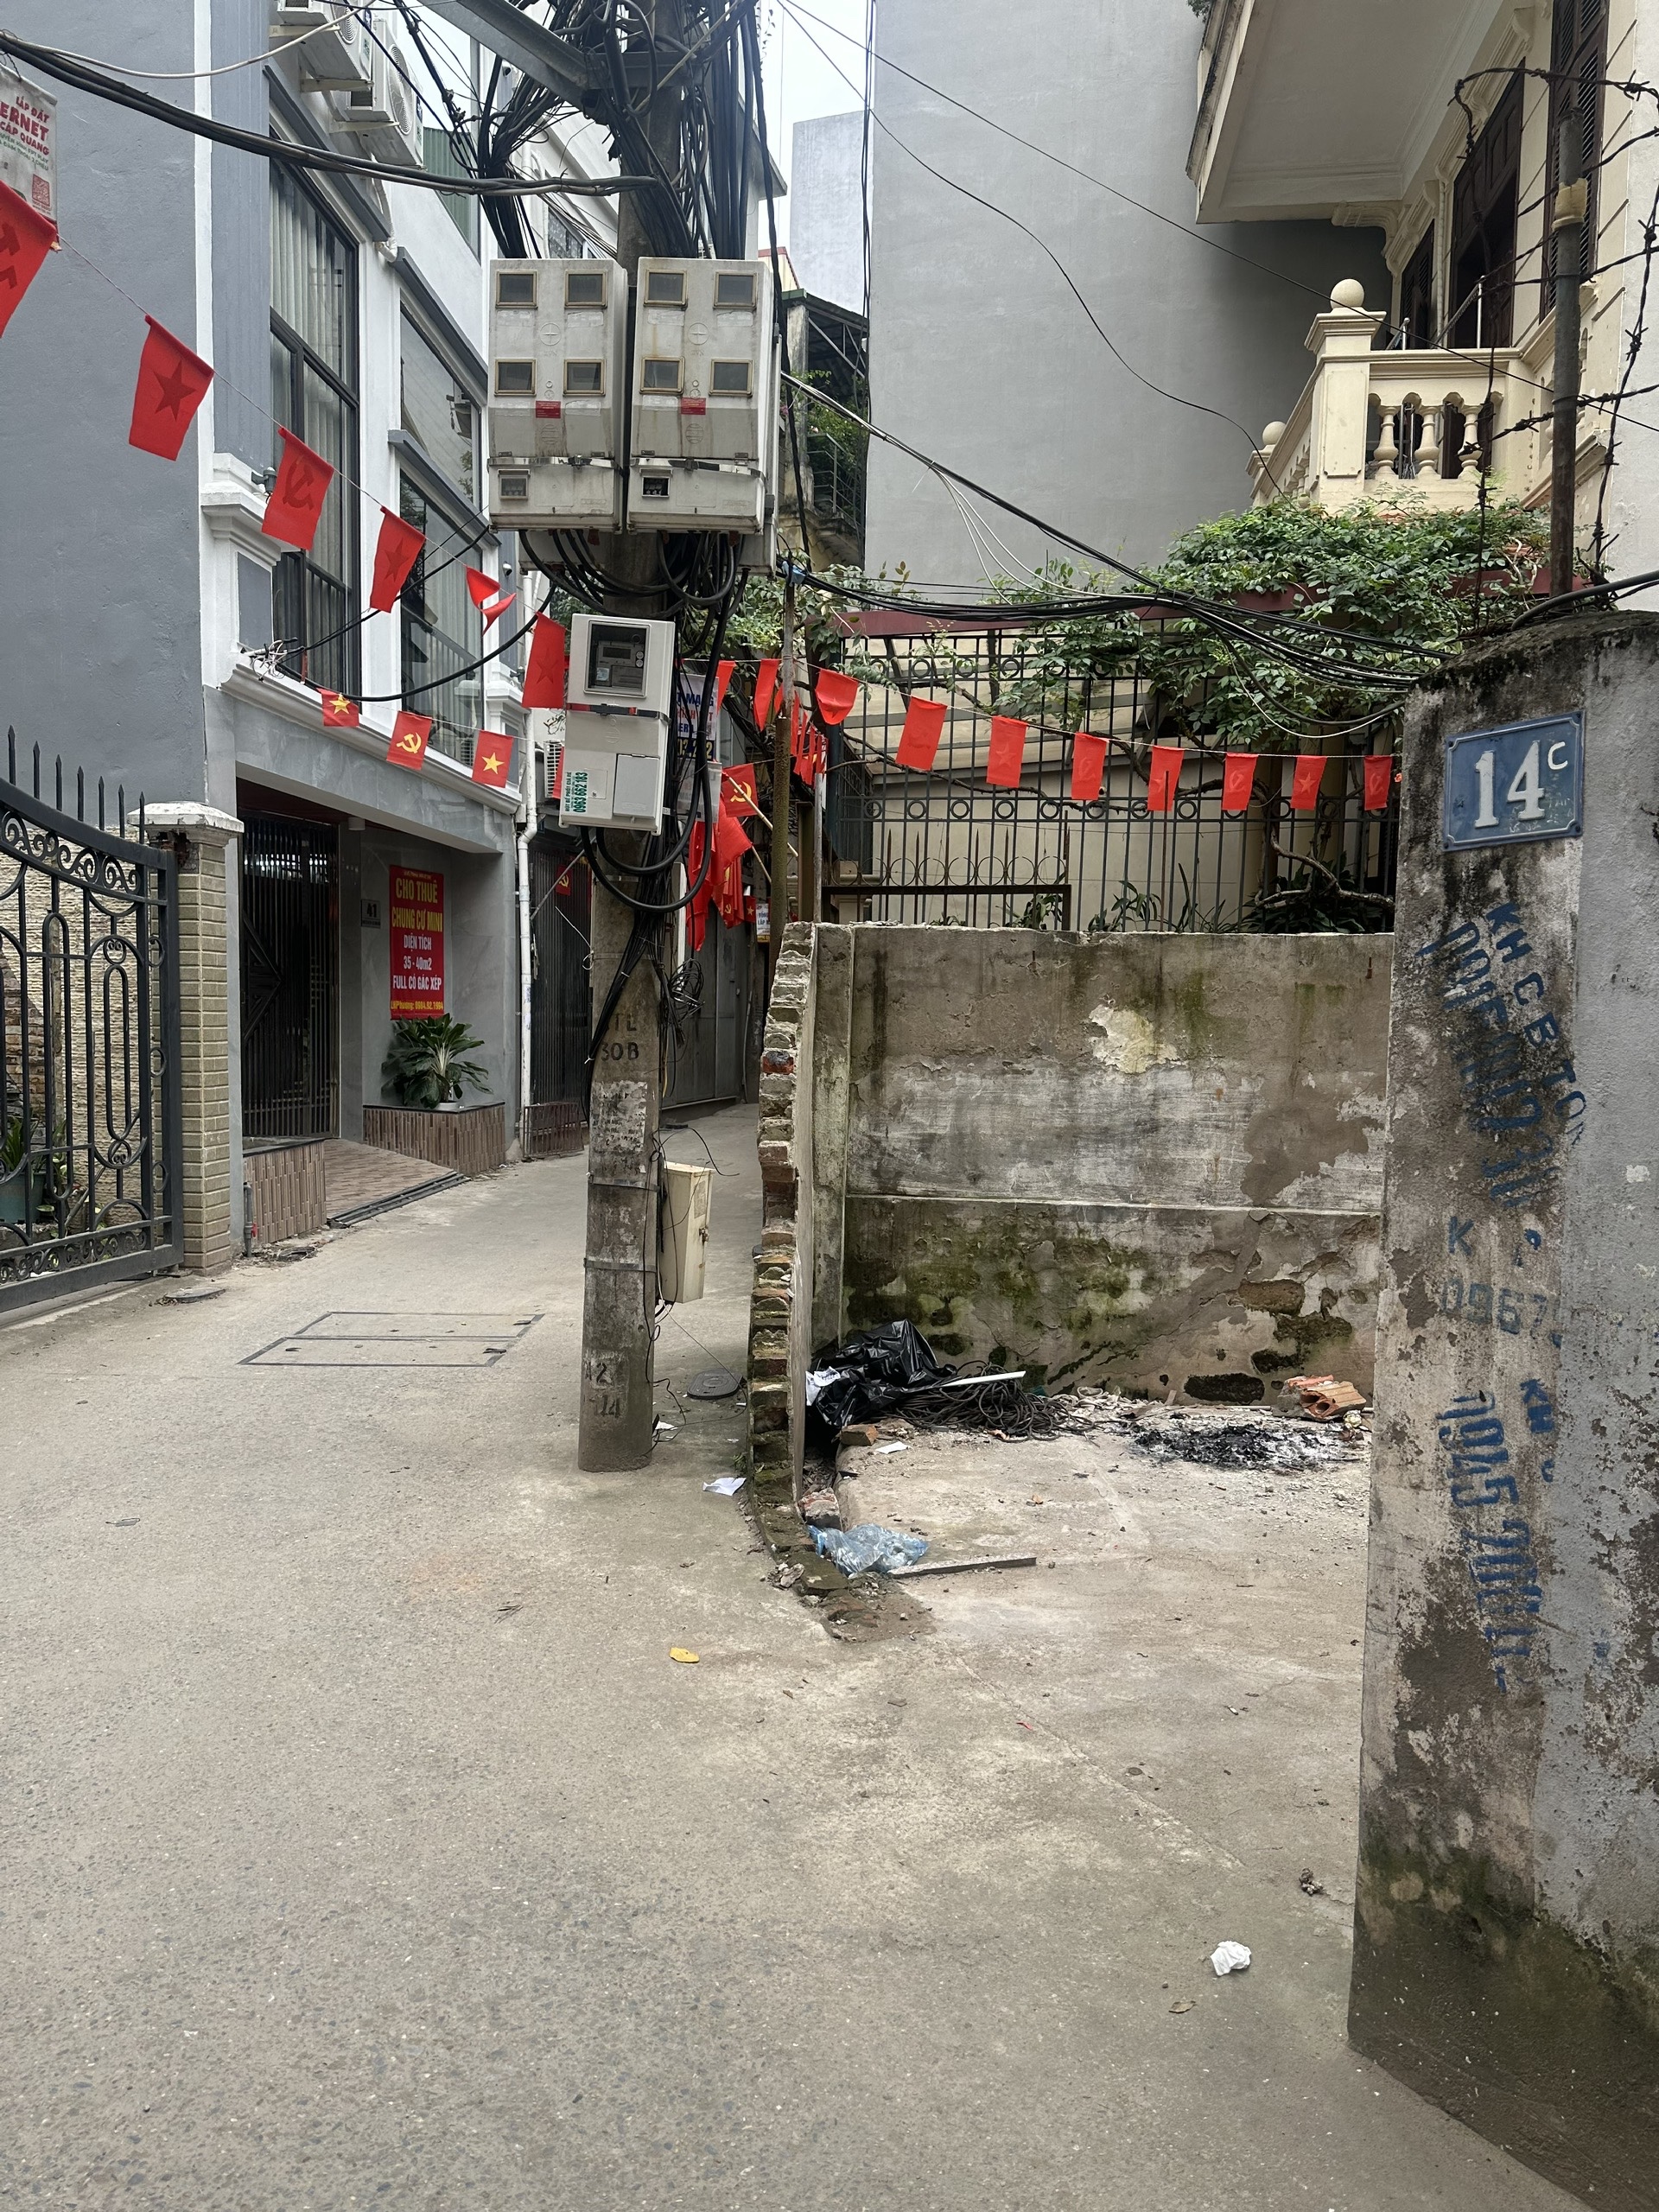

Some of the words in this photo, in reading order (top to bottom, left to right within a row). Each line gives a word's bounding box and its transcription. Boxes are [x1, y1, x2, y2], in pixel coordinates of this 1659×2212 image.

[31, 107, 50, 123] ĐẶT
[20, 132, 50, 156] QUANG
[396, 878, 415, 899] CHO
[416, 880, 438, 904] THUÊ
[391, 906, 415, 930] CHUNG
[427, 912, 442, 932] MINI
[404, 933, 417, 951] DIỆN
[418, 934, 432, 950] TÍCH
[404, 956, 411, 969] 35
[416, 957, 432, 970] 40m2
[393, 975, 407, 989] FULL
[409, 973, 416, 989] CÓ
[417, 974, 429, 990] GÁC
